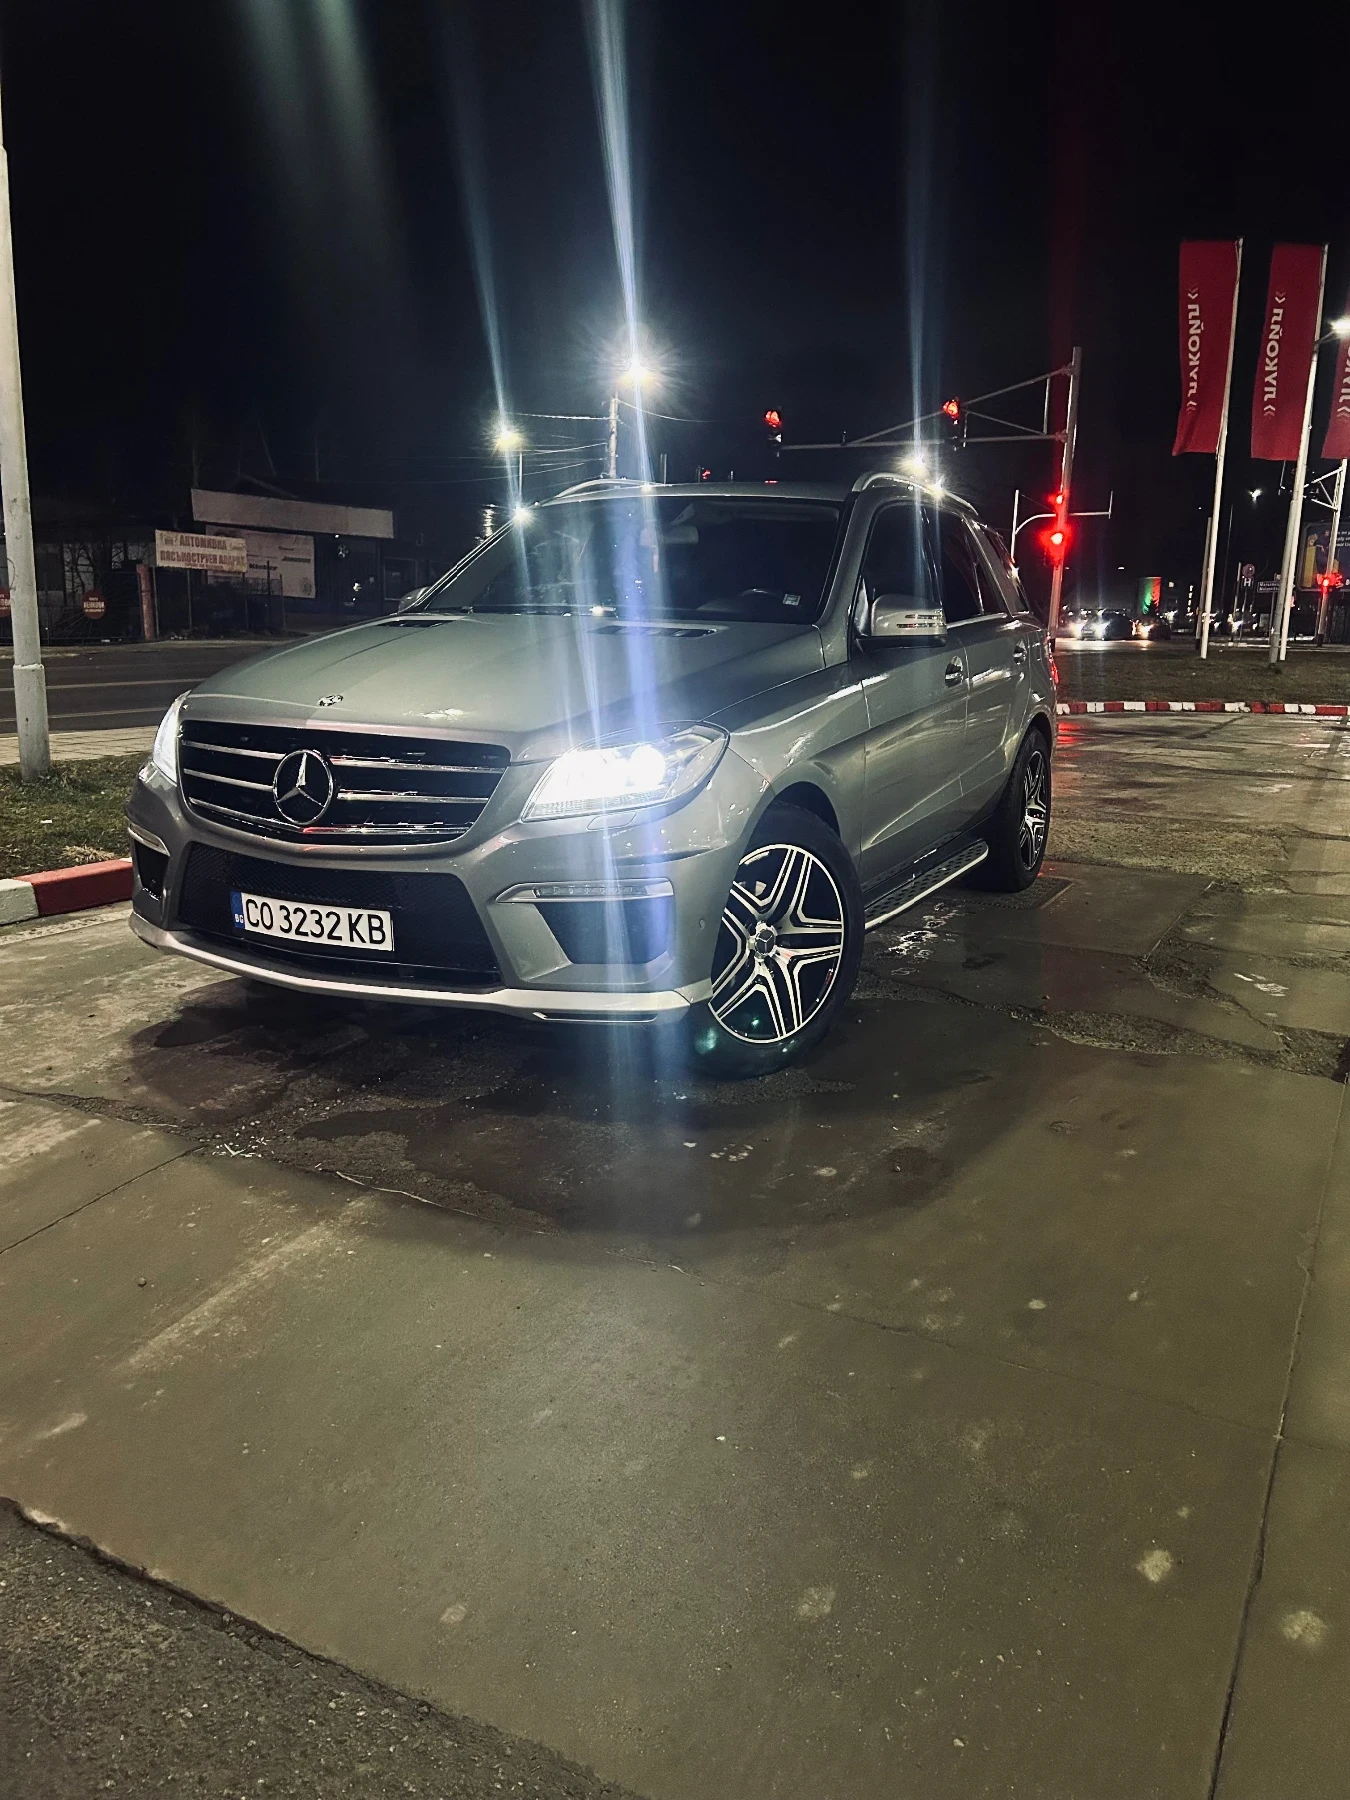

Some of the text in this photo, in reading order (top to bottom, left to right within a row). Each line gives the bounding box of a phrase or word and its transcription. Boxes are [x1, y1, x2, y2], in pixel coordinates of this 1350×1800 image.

[179, 535, 227, 550] АВТОМИВКА
[235, 914, 244, 924] BG
[279, 905, 343, 941] 3232
